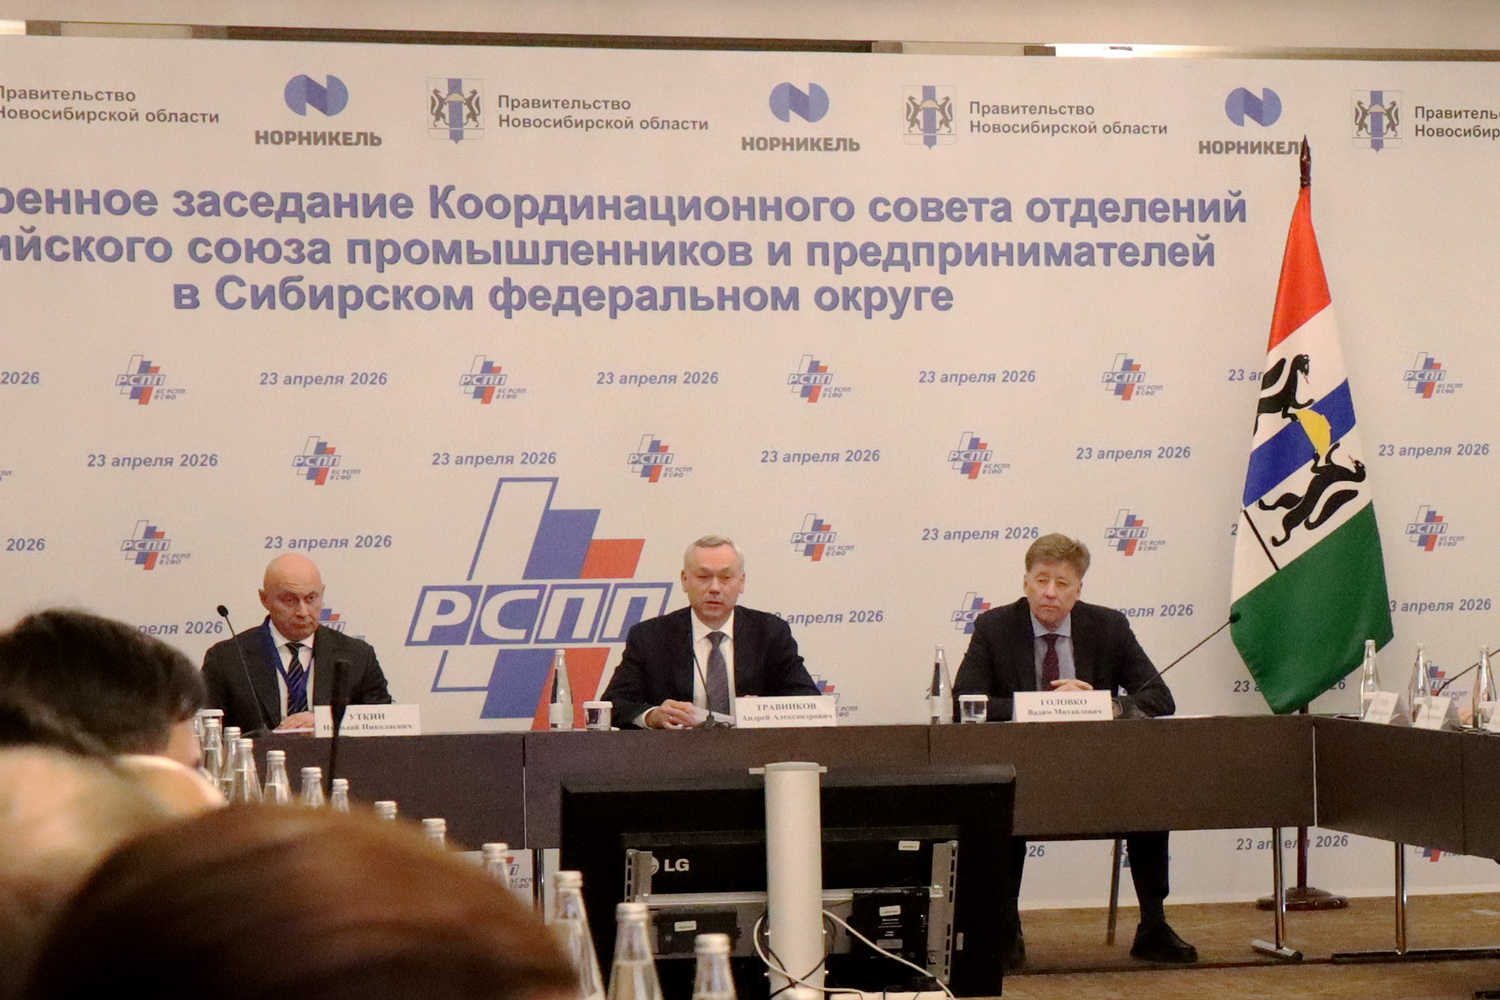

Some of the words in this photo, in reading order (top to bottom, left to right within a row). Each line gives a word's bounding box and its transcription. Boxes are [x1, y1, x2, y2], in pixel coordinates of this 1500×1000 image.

[0, 84, 136, 103] Правительство
[498, 94, 631, 112] Правительство
[969, 100, 1095, 118] Правительство
[145, 108, 220, 124] области
[498, 114, 634, 133] Новосибирской
[639, 116, 709, 131] области
[969, 119, 1098, 137] Новосибирской
[1102, 120, 1168, 135] области
[254, 129, 383, 147] НОРНИКЕЛЬ
[741, 136, 861, 152] НОРНИКЕЛЬ
[1198, 140, 1304, 155] НОРНИКЕЛ
[172, 190, 414, 225] заседание
[429, 184, 855, 229] Координационного
[868, 196, 1013, 223] совета
[1025, 189, 1247, 229] отделений
[187, 237, 332, 265] союза
[347, 238, 753, 274] промышленников
[767, 241, 791, 267] и
[806, 233, 1215, 276] предпринимателей
[173, 283, 201, 310] в
[215, 274, 474, 320] Сибирском
[488, 276, 800, 320] федеральном
[814, 285, 954, 321] округе
[0, 371, 40, 385] 2026
[115, 374, 166, 386] РСПП
[259, 372, 278, 385] 23
[283, 375, 345, 388] апреля
[350, 372, 387, 385] 2026
[459, 374, 507, 386] РСПП
[596, 371, 614, 385] 23
[619, 374, 677, 388] апреля
[683, 371, 719, 384] 2026
[787, 373, 833, 385] РСПП
[918, 370, 936, 383] 23
[940, 373, 996, 386] апреля
[1001, 370, 1036, 383] 2026
[1102, 372, 1146, 383] РСПП
[1228, 368, 1245, 382] 23
[1403, 371, 1446, 382] РСПП
[627, 453, 674, 465] РСПП
[760, 450, 778, 463] 23
[782, 452, 840, 466] апреля
[845, 449, 880, 462] 2026
[947, 450, 993, 462] РСПП
[1076, 447, 1093, 460] 23
[1097, 449, 1152, 462] апреля
[1157, 446, 1191, 459] 2026
[1378, 444, 1395, 457] 23
[1398, 446, 1452, 459] апреля
[1456, 443, 1489, 456] 2026
[87, 454, 106, 467] 23
[111, 457, 174, 470] апреля
[179, 453, 218, 467] 2026
[292, 455, 341, 467] РСПП
[431, 452, 450, 466] 23
[454, 455, 514, 468] апреля
[520, 451, 556, 465] 2026
[921, 528, 939, 541] 23
[943, 530, 999, 543] апреля
[1004, 526, 1039, 540] 2026
[1103, 527, 1148, 538] РСПП
[1405, 523, 1448, 534] РСПП
[6, 538, 46, 552] 2026
[120, 539, 171, 551] РСПП
[264, 535, 283, 549] 23
[288, 538, 349, 552] апреля
[354, 534, 392, 548] 2026
[790, 532, 836, 544] РСПП
[405, 582, 673, 646] РСПП
[1116, 607, 1155, 618] реля
[1159, 603, 1194, 617] 2026
[1401, 602, 1454, 615] апреля
[1458, 598, 1491, 611] 2026
[787, 613, 843, 626] апреля
[848, 610, 884, 623] 2026
[135, 624, 178, 636] реля
[184, 621, 223, 635] 2026
[1233, 681, 1250, 693] 23
[757, 703, 817, 711] ТРАВНИКОВ
[349, 713, 385, 721] УТКИН
[1236, 838, 1253, 851] 23
[1316, 835, 1349, 847] 2026
[664, 858, 690, 873] LG
